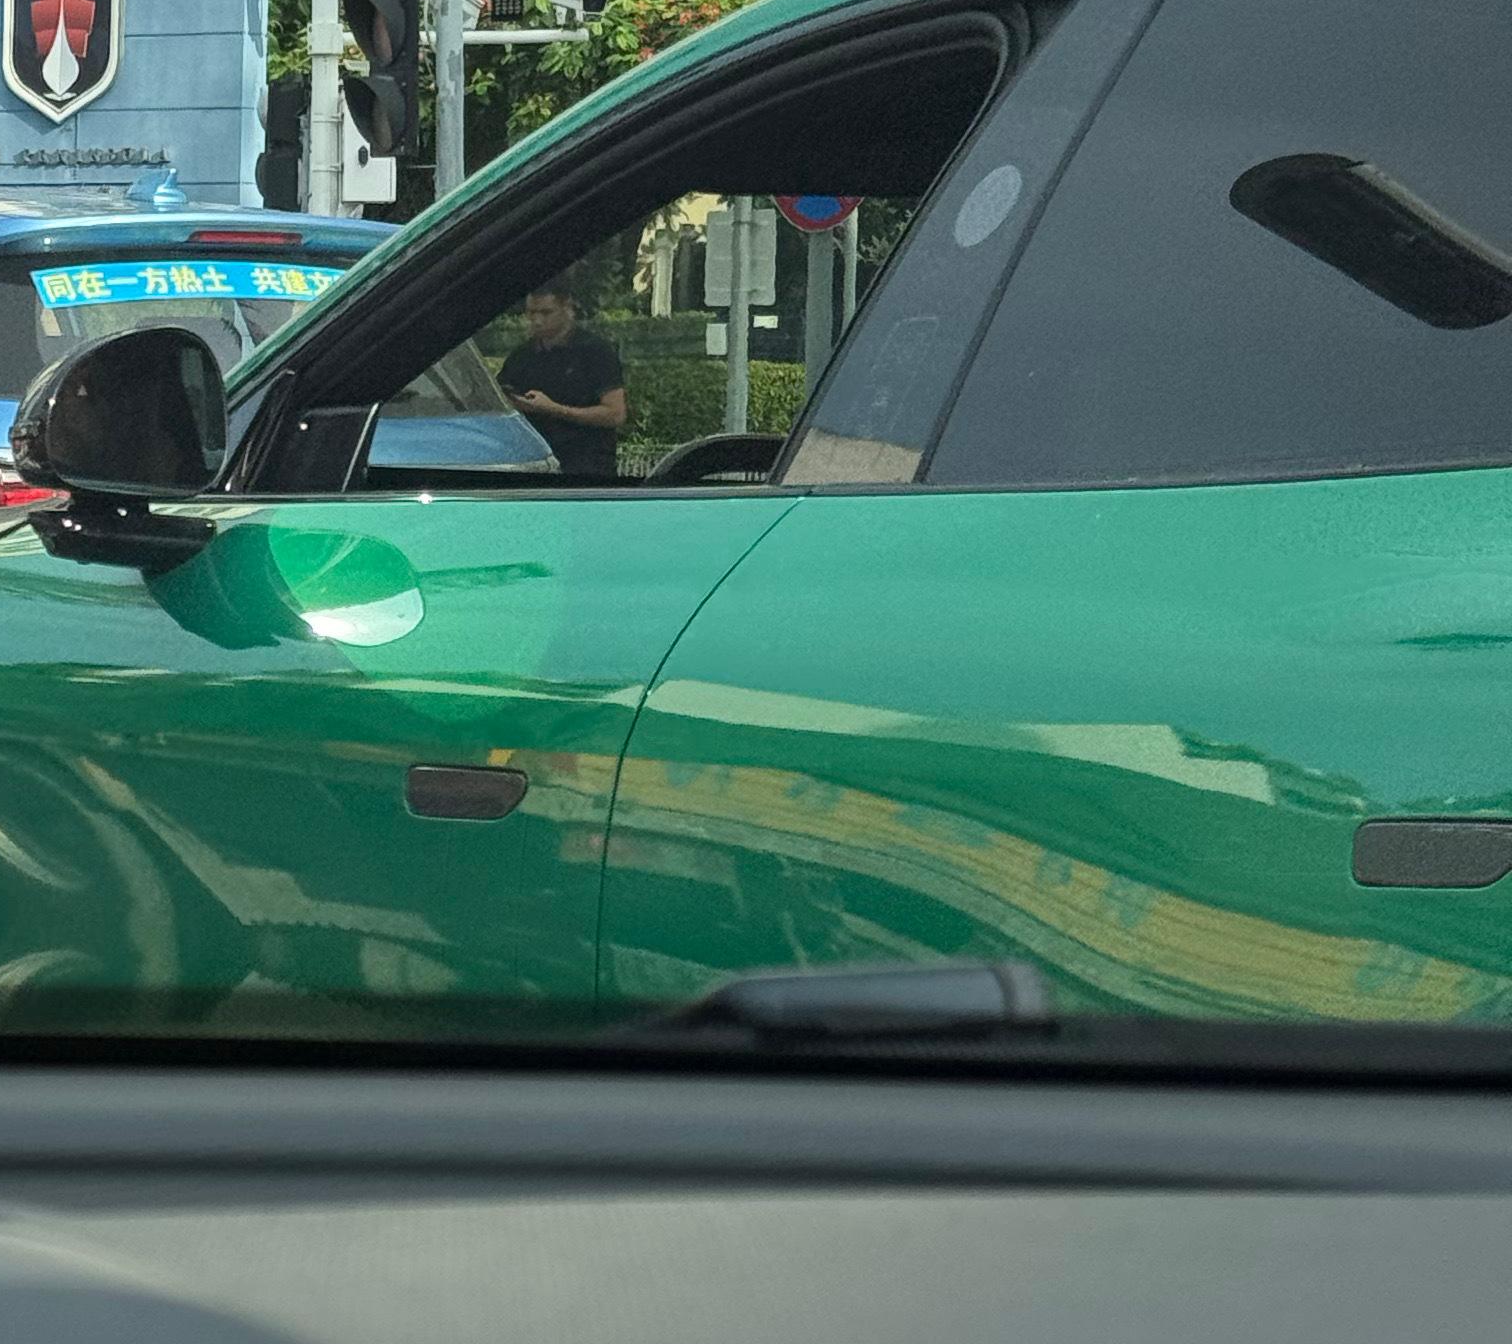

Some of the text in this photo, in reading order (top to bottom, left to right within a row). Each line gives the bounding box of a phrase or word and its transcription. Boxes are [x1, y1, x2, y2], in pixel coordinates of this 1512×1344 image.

[41, 265, 340, 303] 同在一方热土 共建文
